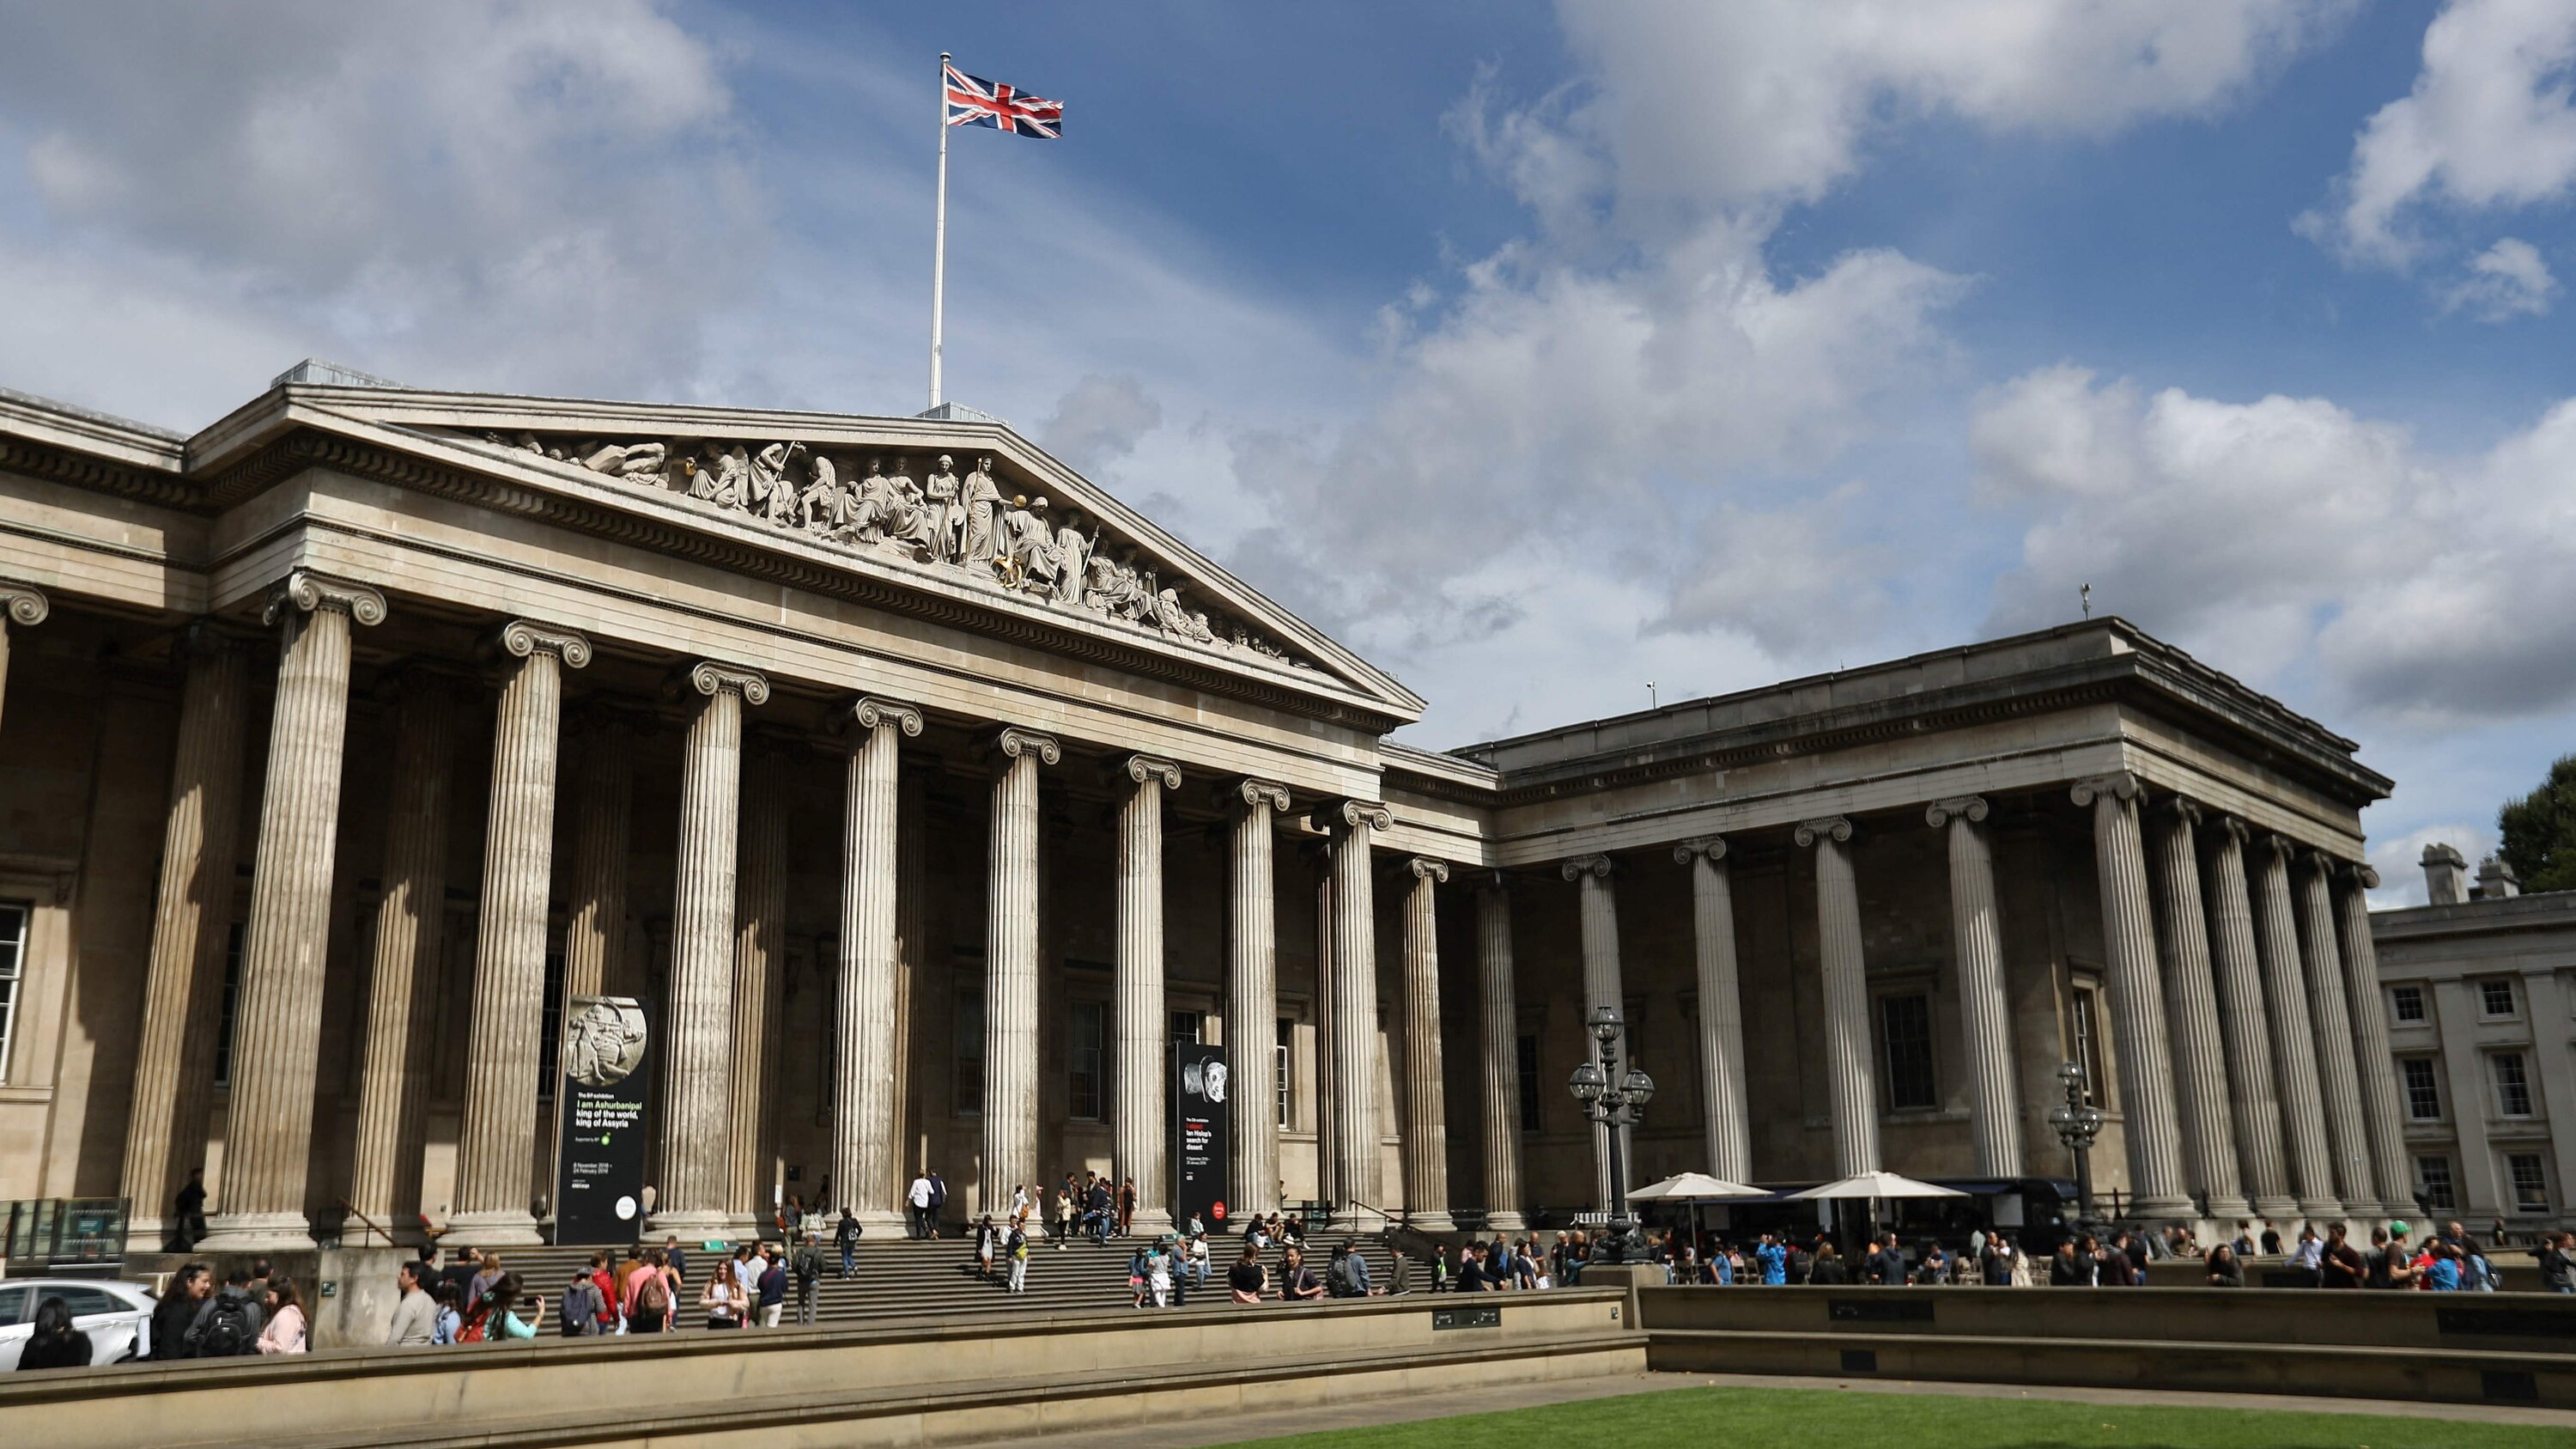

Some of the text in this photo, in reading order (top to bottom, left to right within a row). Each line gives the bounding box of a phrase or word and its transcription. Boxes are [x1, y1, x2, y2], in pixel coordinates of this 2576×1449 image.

[577, 1099, 580, 1108] I
[595, 1100, 642, 1111] Ashurbanipal
[577, 1109, 638, 1120] king of the world,
[576, 1118, 629, 1129] king of Assyria
